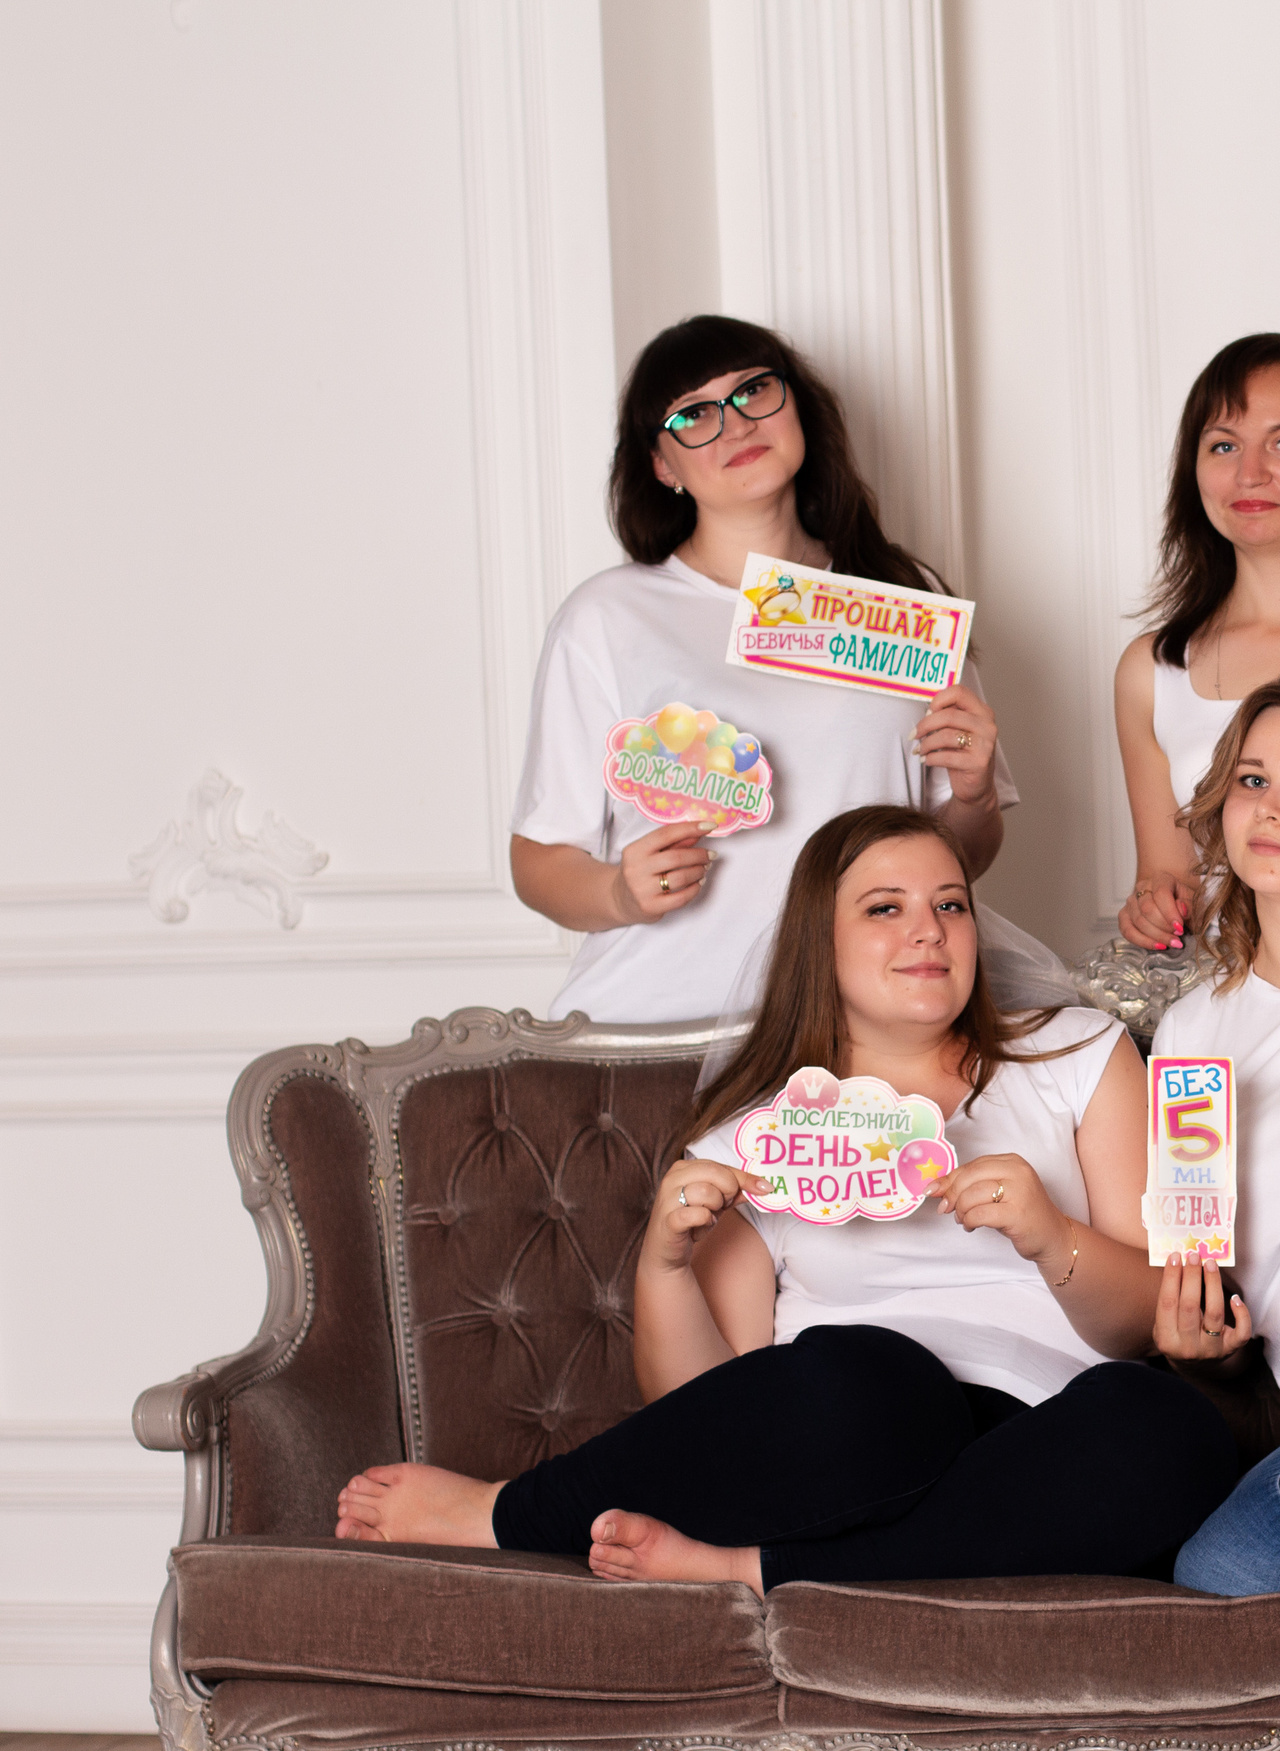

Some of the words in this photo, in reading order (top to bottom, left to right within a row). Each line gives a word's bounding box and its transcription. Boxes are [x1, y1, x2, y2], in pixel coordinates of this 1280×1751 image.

[742, 632, 824, 651] ДЕВИЧЬЯ
[829, 633, 948, 684] ФАМИЛИЯ!
[616, 751, 764, 813] ДОЖДАЛИСЬ!
[1164, 1067, 1222, 1098] БЕЗ
[782, 1109, 911, 1131] ПОСЛЕДНИЙ
[1163, 1096, 1223, 1164] 5
[756, 1133, 861, 1167] ДЕНЬ
[797, 1168, 898, 1205] ВОЛЕ!
[1172, 1167, 1216, 1184] МН.
